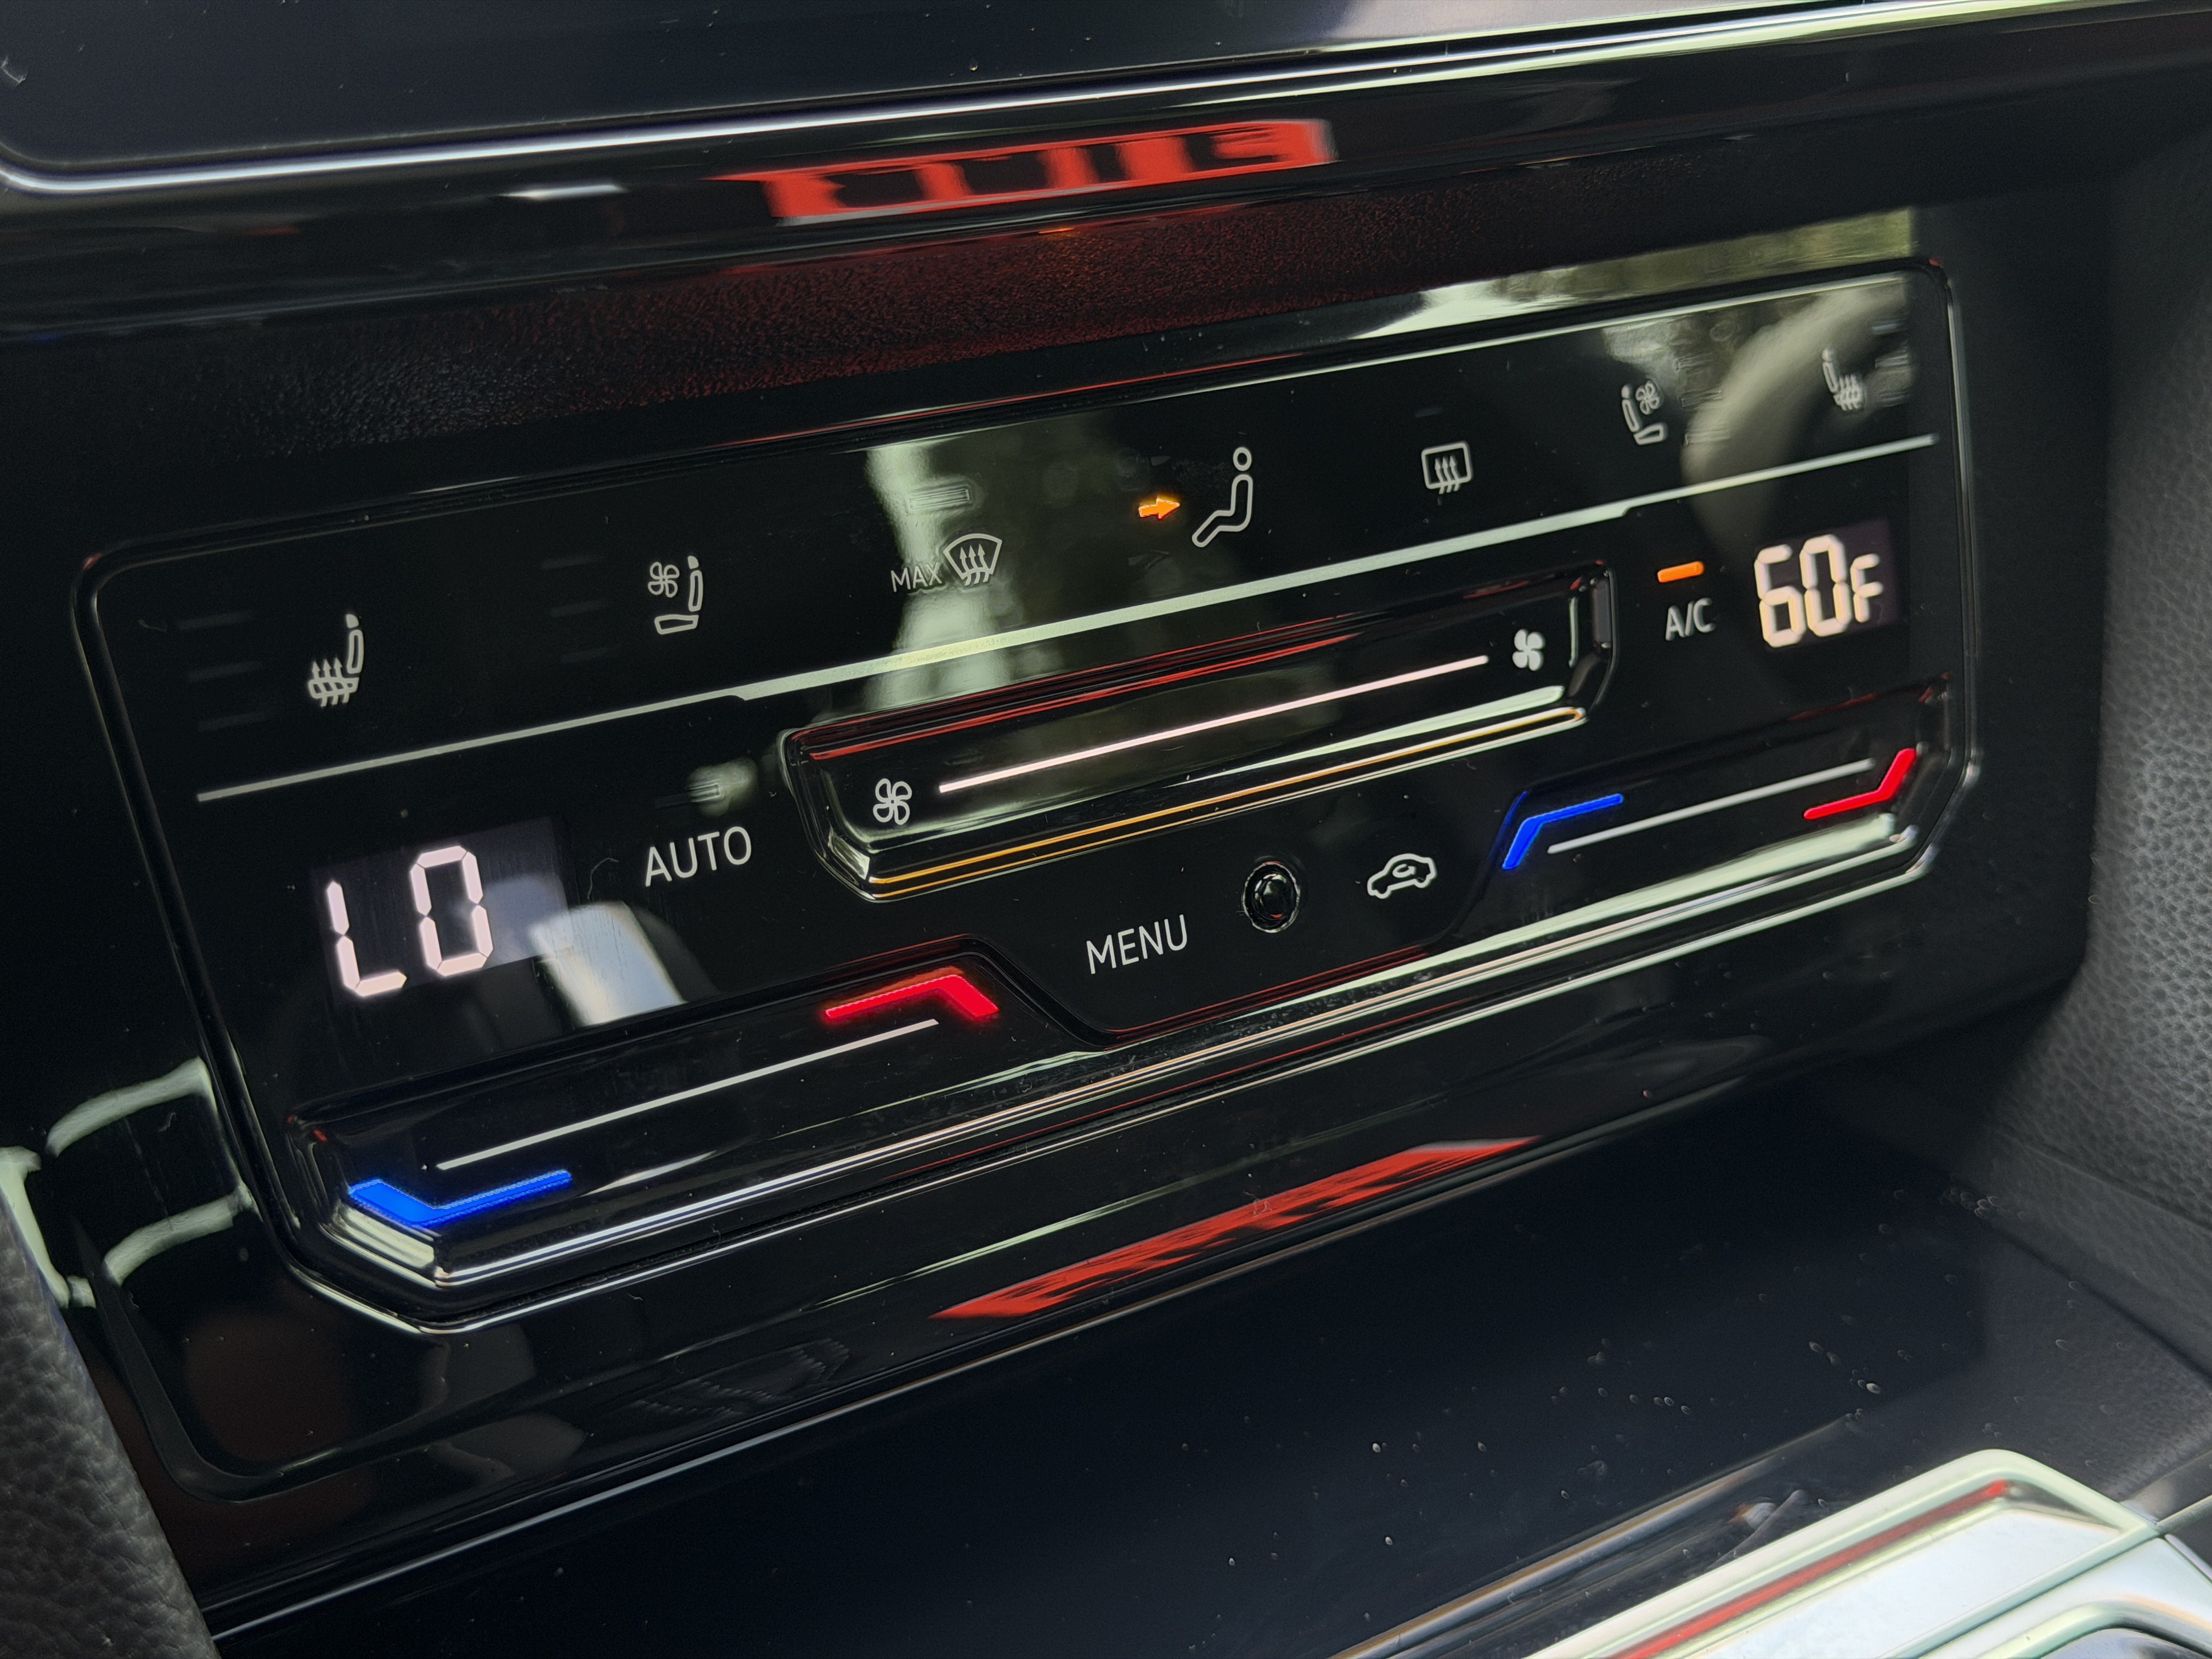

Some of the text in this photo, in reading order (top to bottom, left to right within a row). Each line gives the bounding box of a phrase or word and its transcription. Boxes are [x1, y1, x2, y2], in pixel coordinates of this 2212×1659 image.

[890, 562, 943, 592] MAX
[1665, 597, 1717, 641] A/C
[645, 826, 752, 887] AUTO
[326, 845, 493, 997] LO
[1086, 914, 1187, 974] MENU
